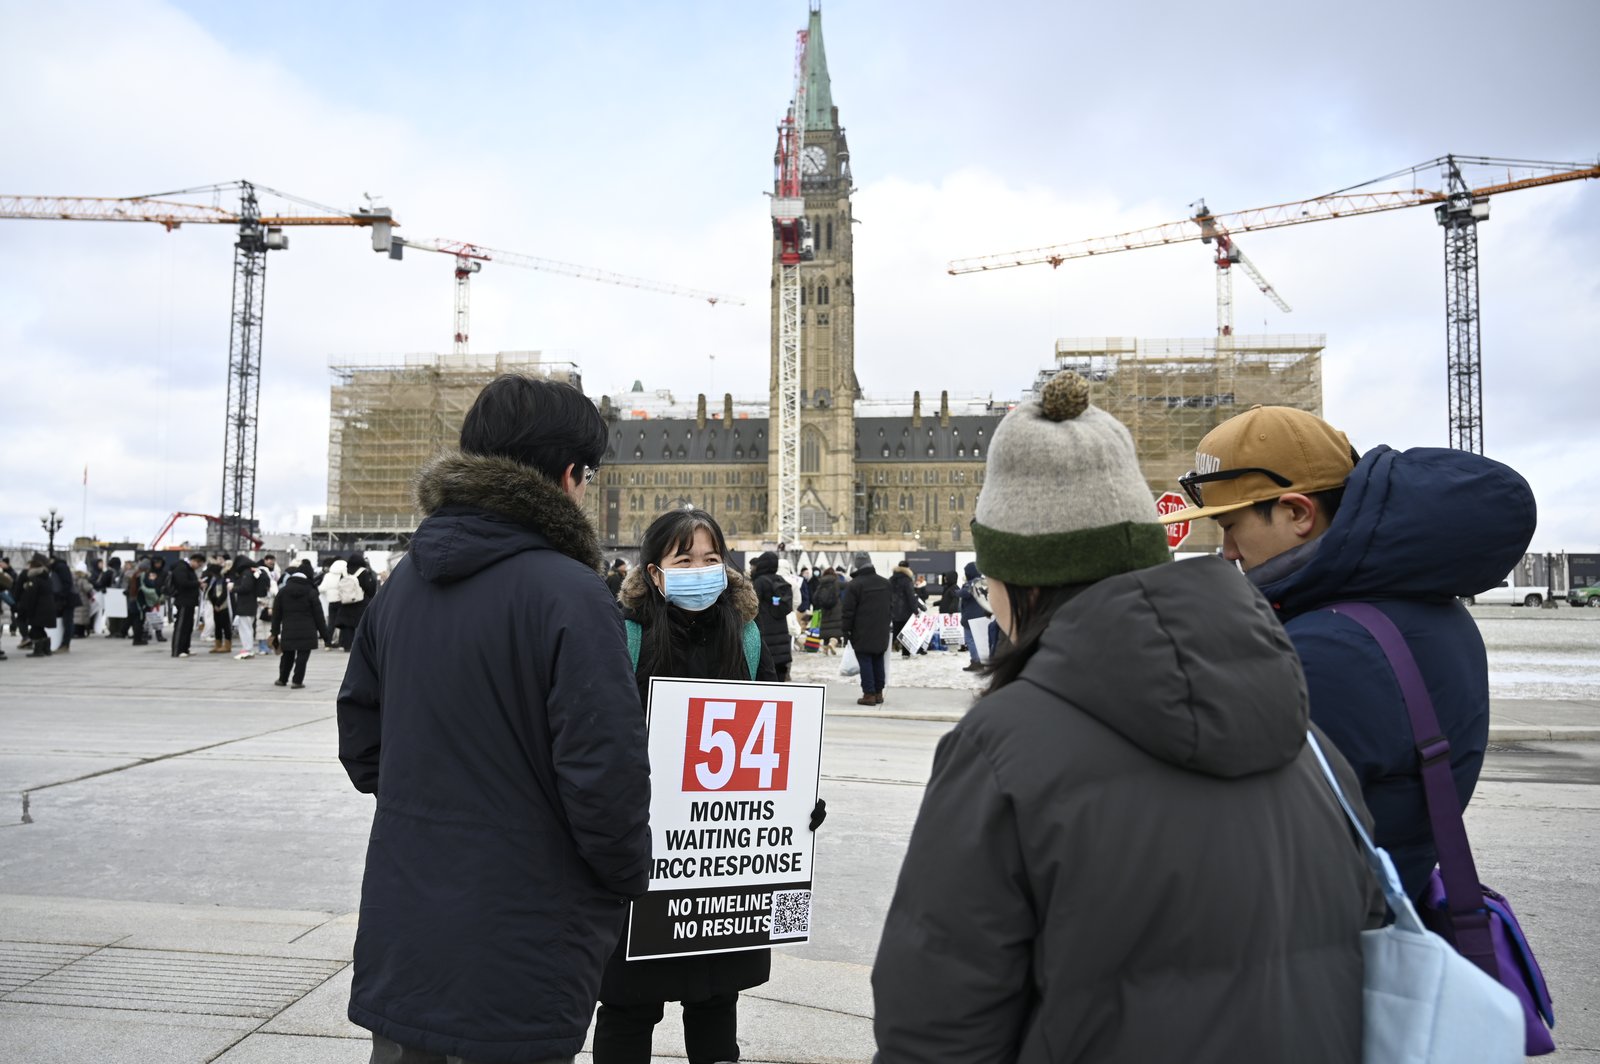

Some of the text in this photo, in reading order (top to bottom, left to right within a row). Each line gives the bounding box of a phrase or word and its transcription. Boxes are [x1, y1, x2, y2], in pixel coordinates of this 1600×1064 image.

[695, 701, 779, 790] 54
[690, 800, 774, 822] MONTHS
[665, 826, 793, 850] WAITING FOR
[649, 852, 803, 880] IRCC RESPONSE
[667, 893, 773, 917] NO TIMELINE
[673, 915, 771, 940] NO RESULTS
